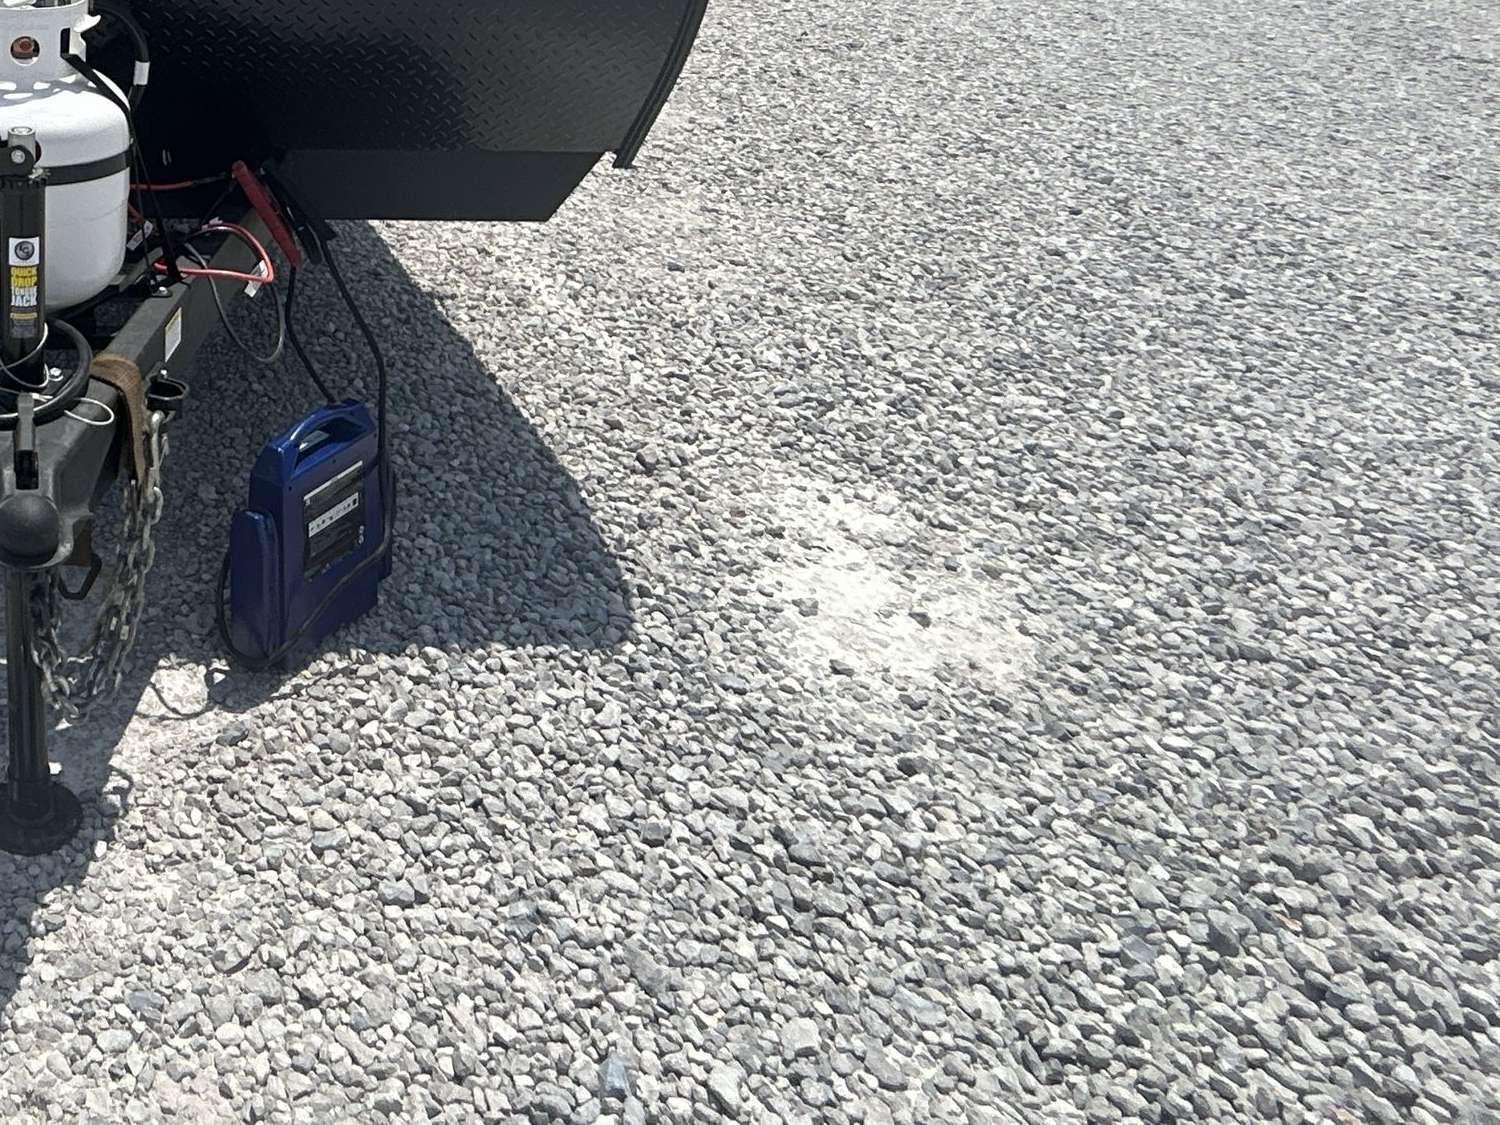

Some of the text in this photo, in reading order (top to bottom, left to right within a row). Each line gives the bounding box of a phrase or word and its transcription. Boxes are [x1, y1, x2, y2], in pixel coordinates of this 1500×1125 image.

[10, 265, 38, 276] QUICK
[10, 275, 38, 288] DROP
[11, 294, 38, 307] JACK
